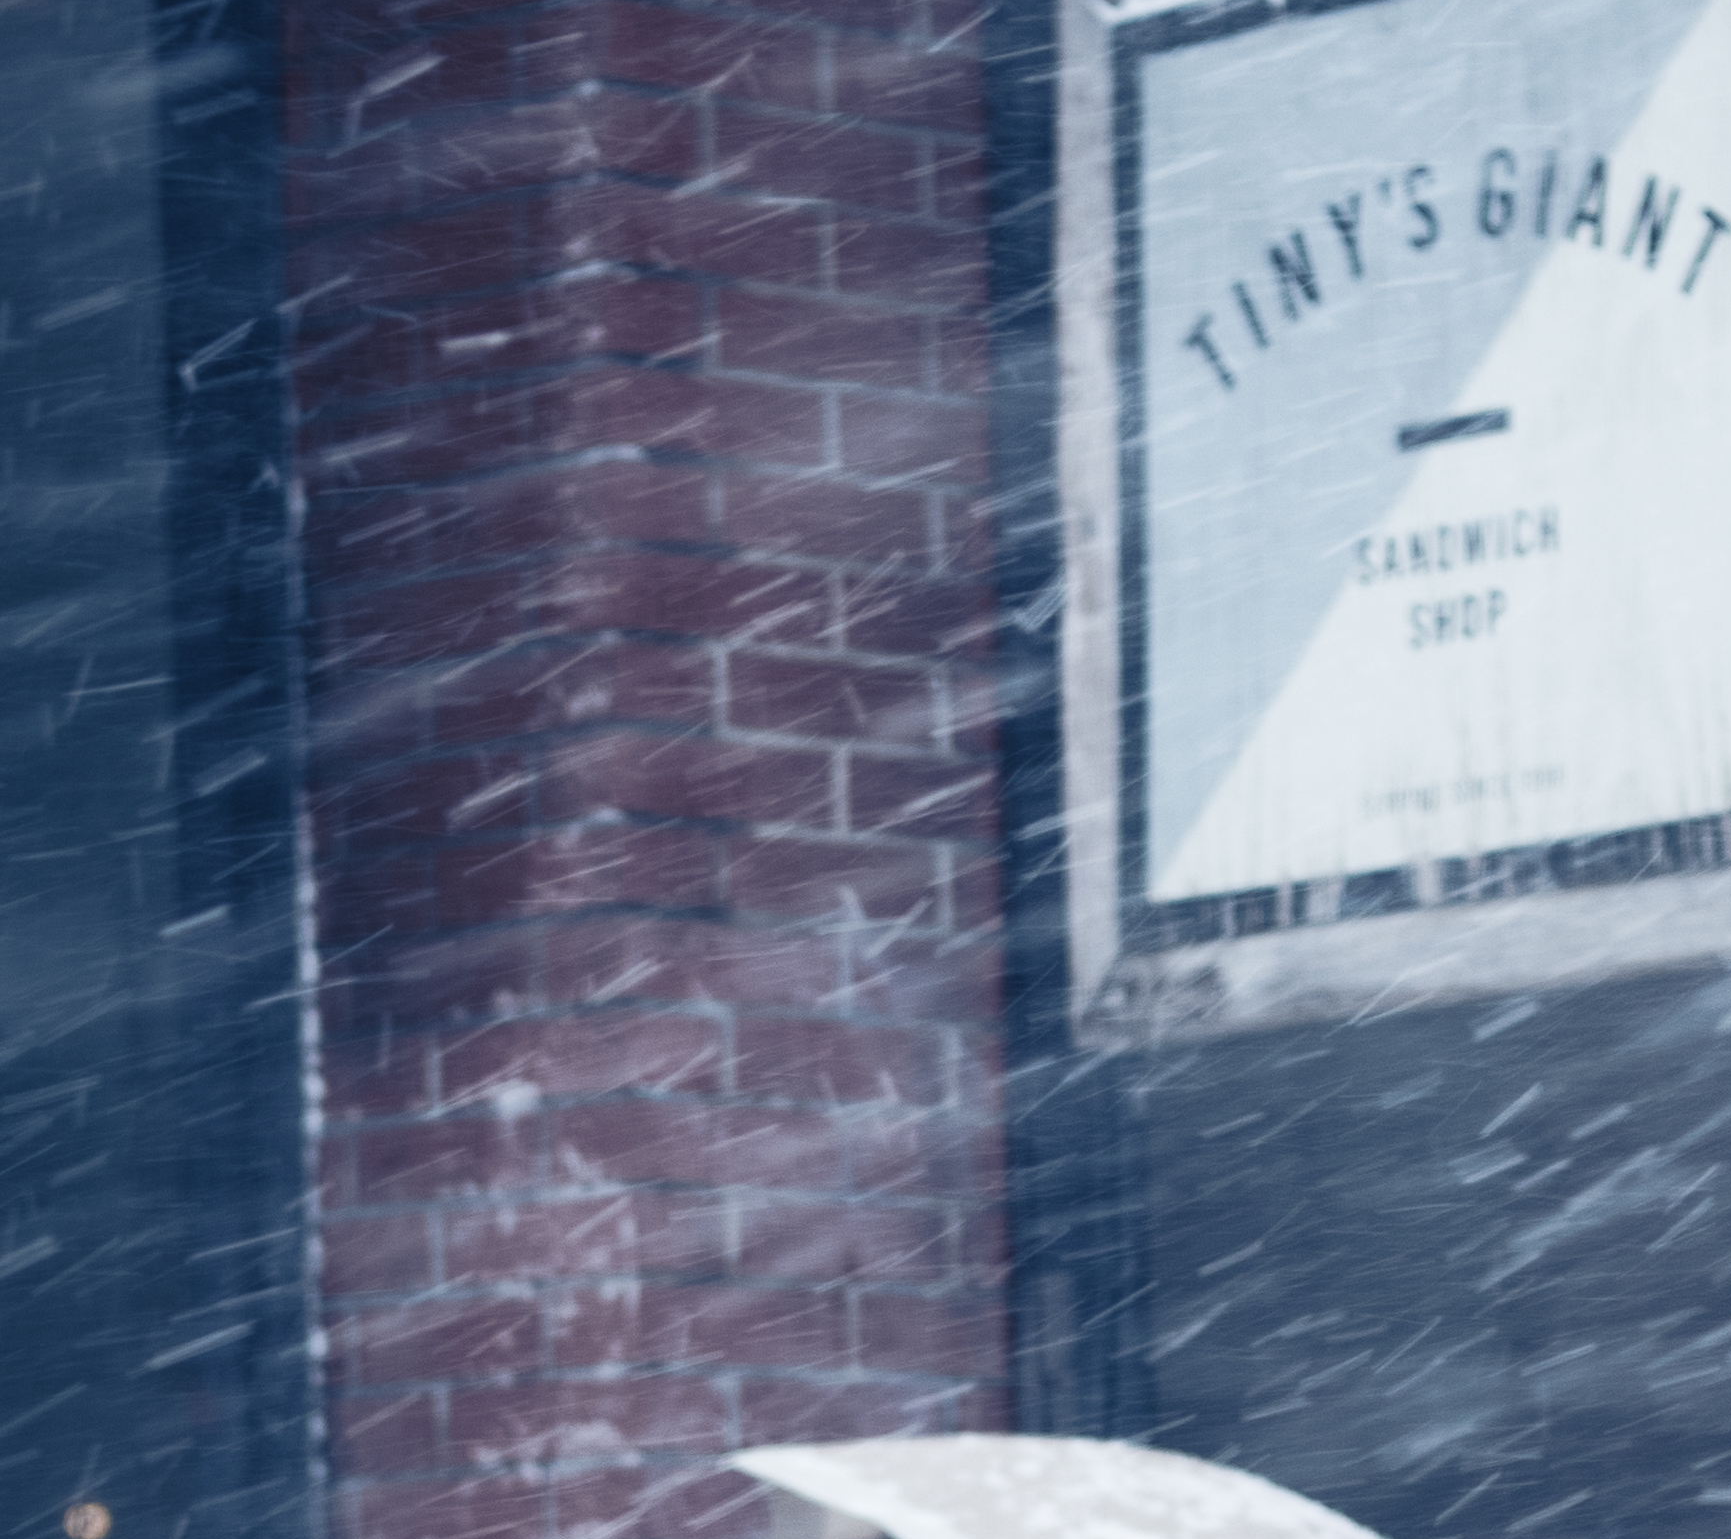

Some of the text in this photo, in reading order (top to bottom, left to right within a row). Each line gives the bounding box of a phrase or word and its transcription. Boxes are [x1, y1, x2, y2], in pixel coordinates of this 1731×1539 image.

[1183, 147, 1731, 391] TINY'S GIANT
[1356, 507, 1559, 586] SANDWICH
[1409, 589, 1507, 650] SHOP
